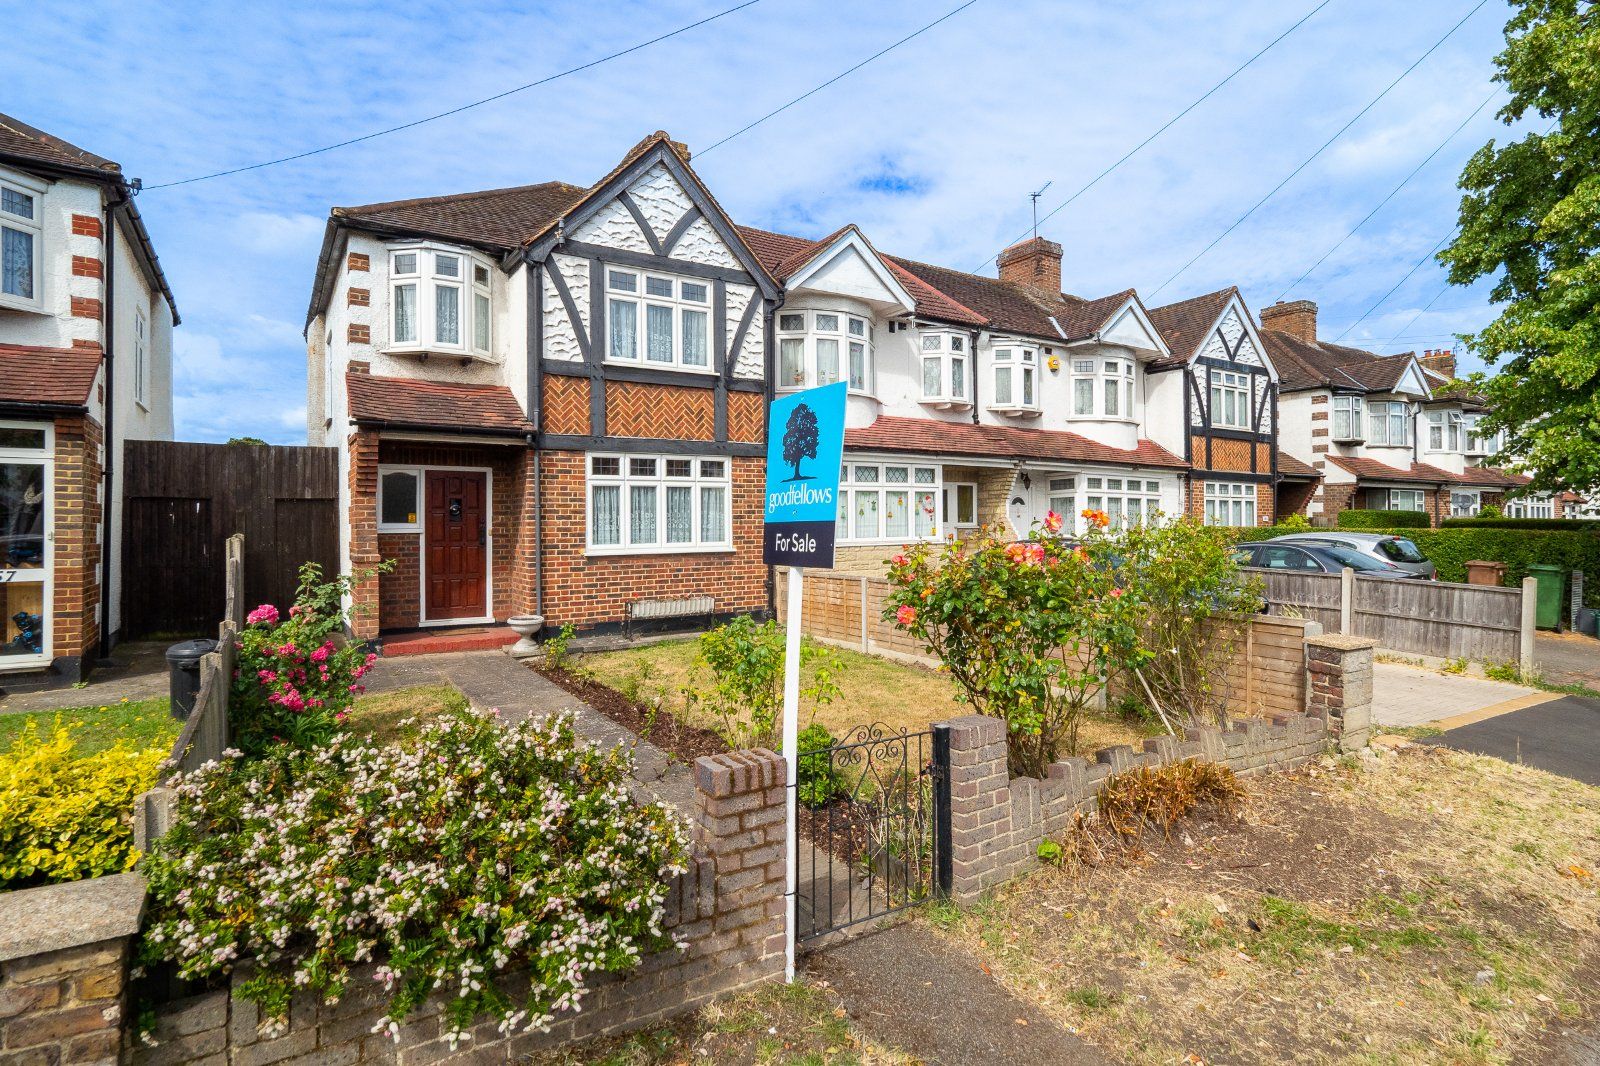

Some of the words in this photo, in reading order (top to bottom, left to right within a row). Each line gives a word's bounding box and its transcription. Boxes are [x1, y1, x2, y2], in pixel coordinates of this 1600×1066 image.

[769, 483, 832, 513] goodfellows
[775, 533, 790, 552] For
[791, 533, 817, 553] Sale
